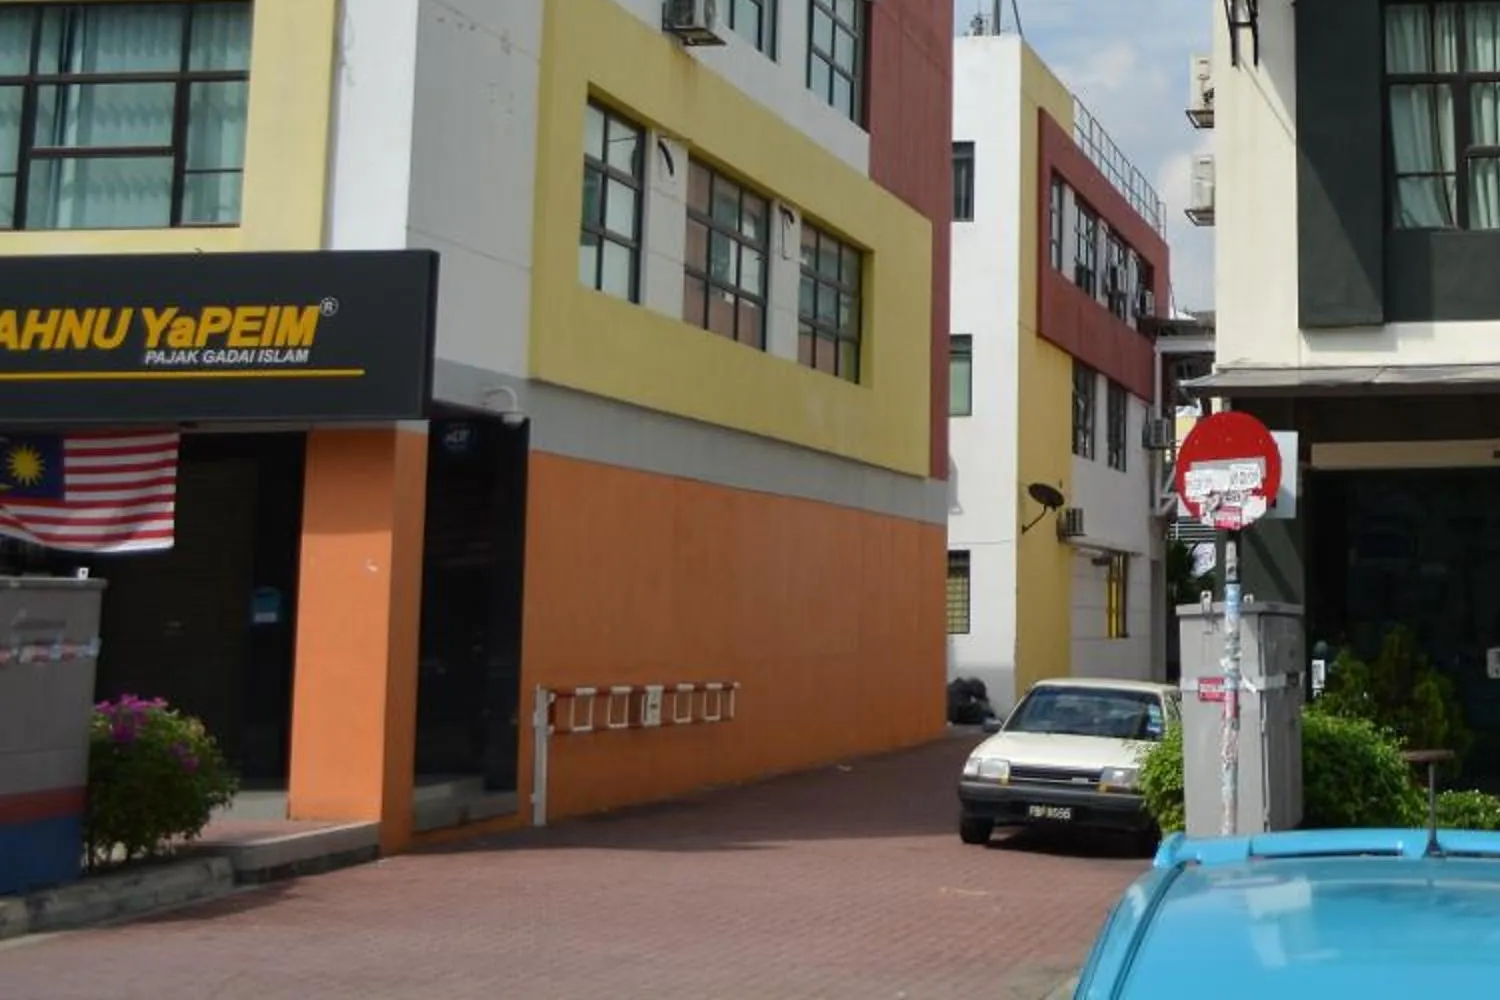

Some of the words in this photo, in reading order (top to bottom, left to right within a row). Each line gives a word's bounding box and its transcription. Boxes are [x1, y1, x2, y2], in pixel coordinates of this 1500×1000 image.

[141, 305, 321, 349] YaPEIM
[145, 350, 201, 365] PAJAK
[203, 349, 255, 364] GADAI
[257, 349, 309, 363] ISLAM
